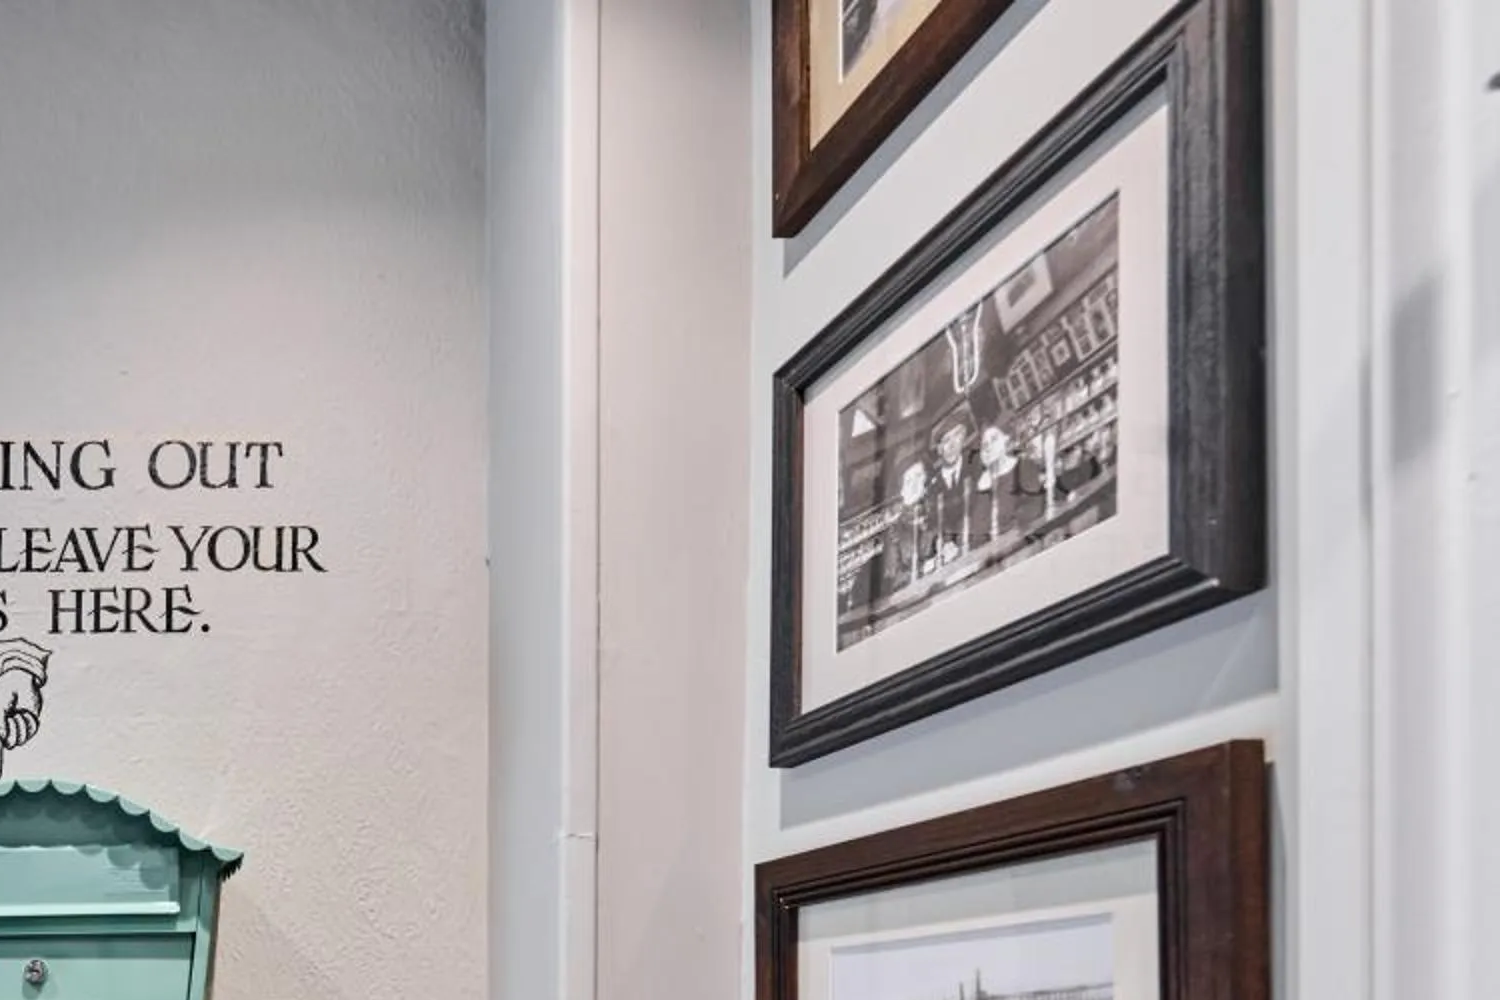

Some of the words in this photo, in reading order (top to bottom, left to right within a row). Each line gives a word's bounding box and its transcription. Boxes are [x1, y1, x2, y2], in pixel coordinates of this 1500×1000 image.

[147, 440, 283, 491] OUT
[167, 524, 329, 574] YOUR
[47, 585, 211, 637] HERE.
